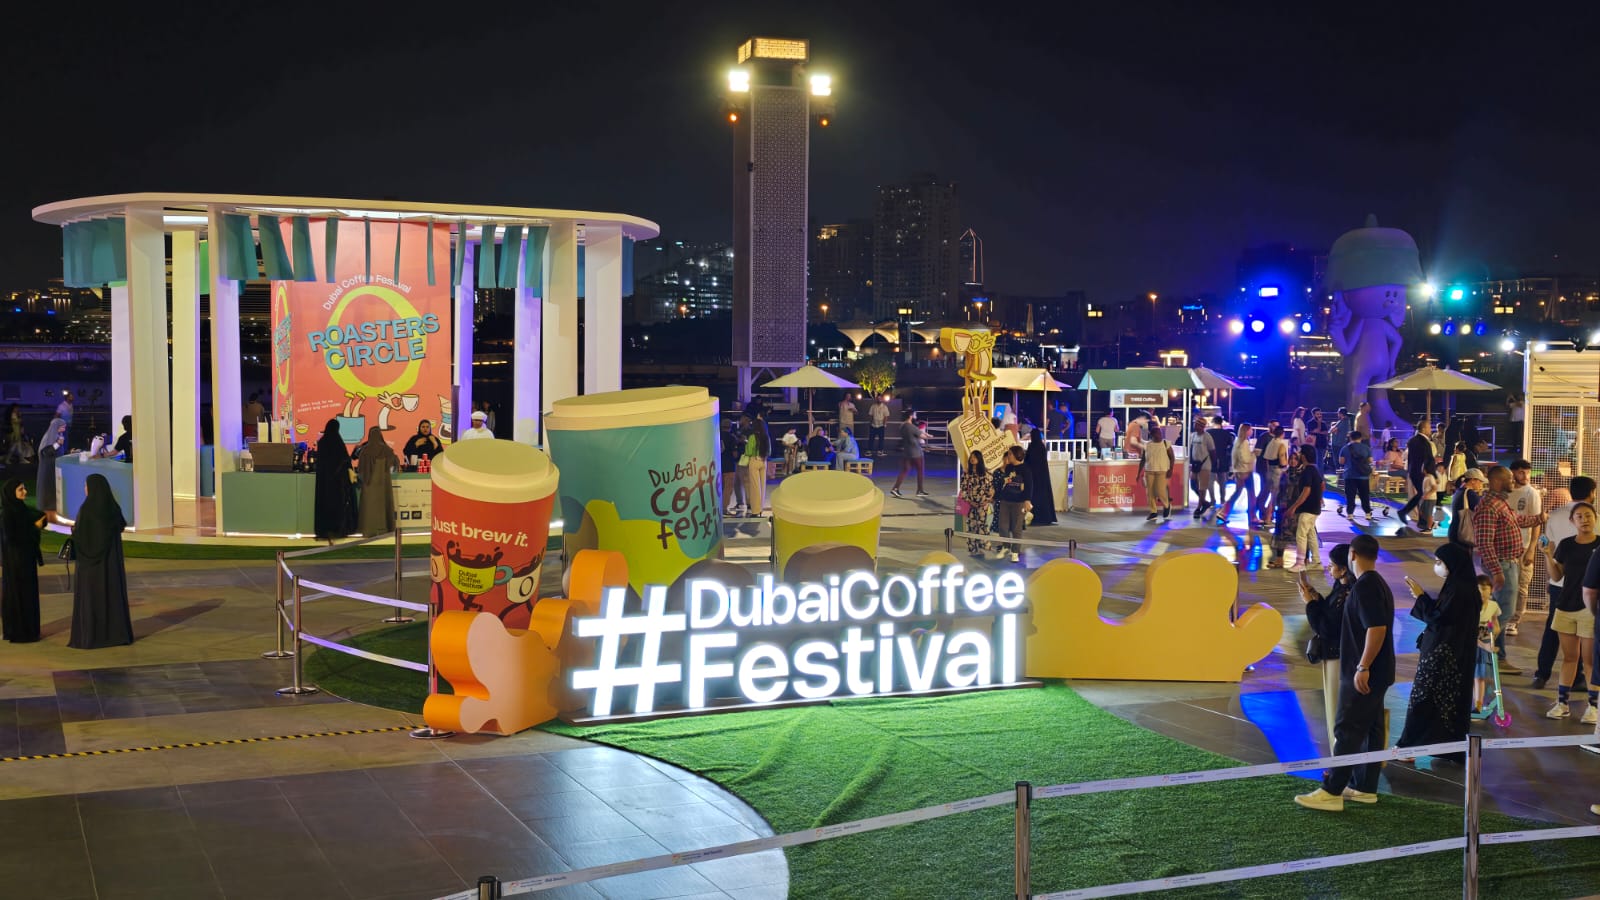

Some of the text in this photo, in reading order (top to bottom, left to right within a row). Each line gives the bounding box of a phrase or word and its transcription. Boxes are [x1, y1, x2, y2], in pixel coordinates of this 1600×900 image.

[322, 285, 343, 311] Dubai
[307, 313, 440, 352] ROASTERS
[325, 338, 426, 369] CIRCLE
[648, 457, 697, 488] Dubai
[1098, 473, 1126, 484] Dubai
[1097, 494, 1135, 505] Festival
[1098, 484, 1131, 495] Coffee
[433, 516, 529, 548] Just brew it.
[687, 613, 1018, 709] Festival
